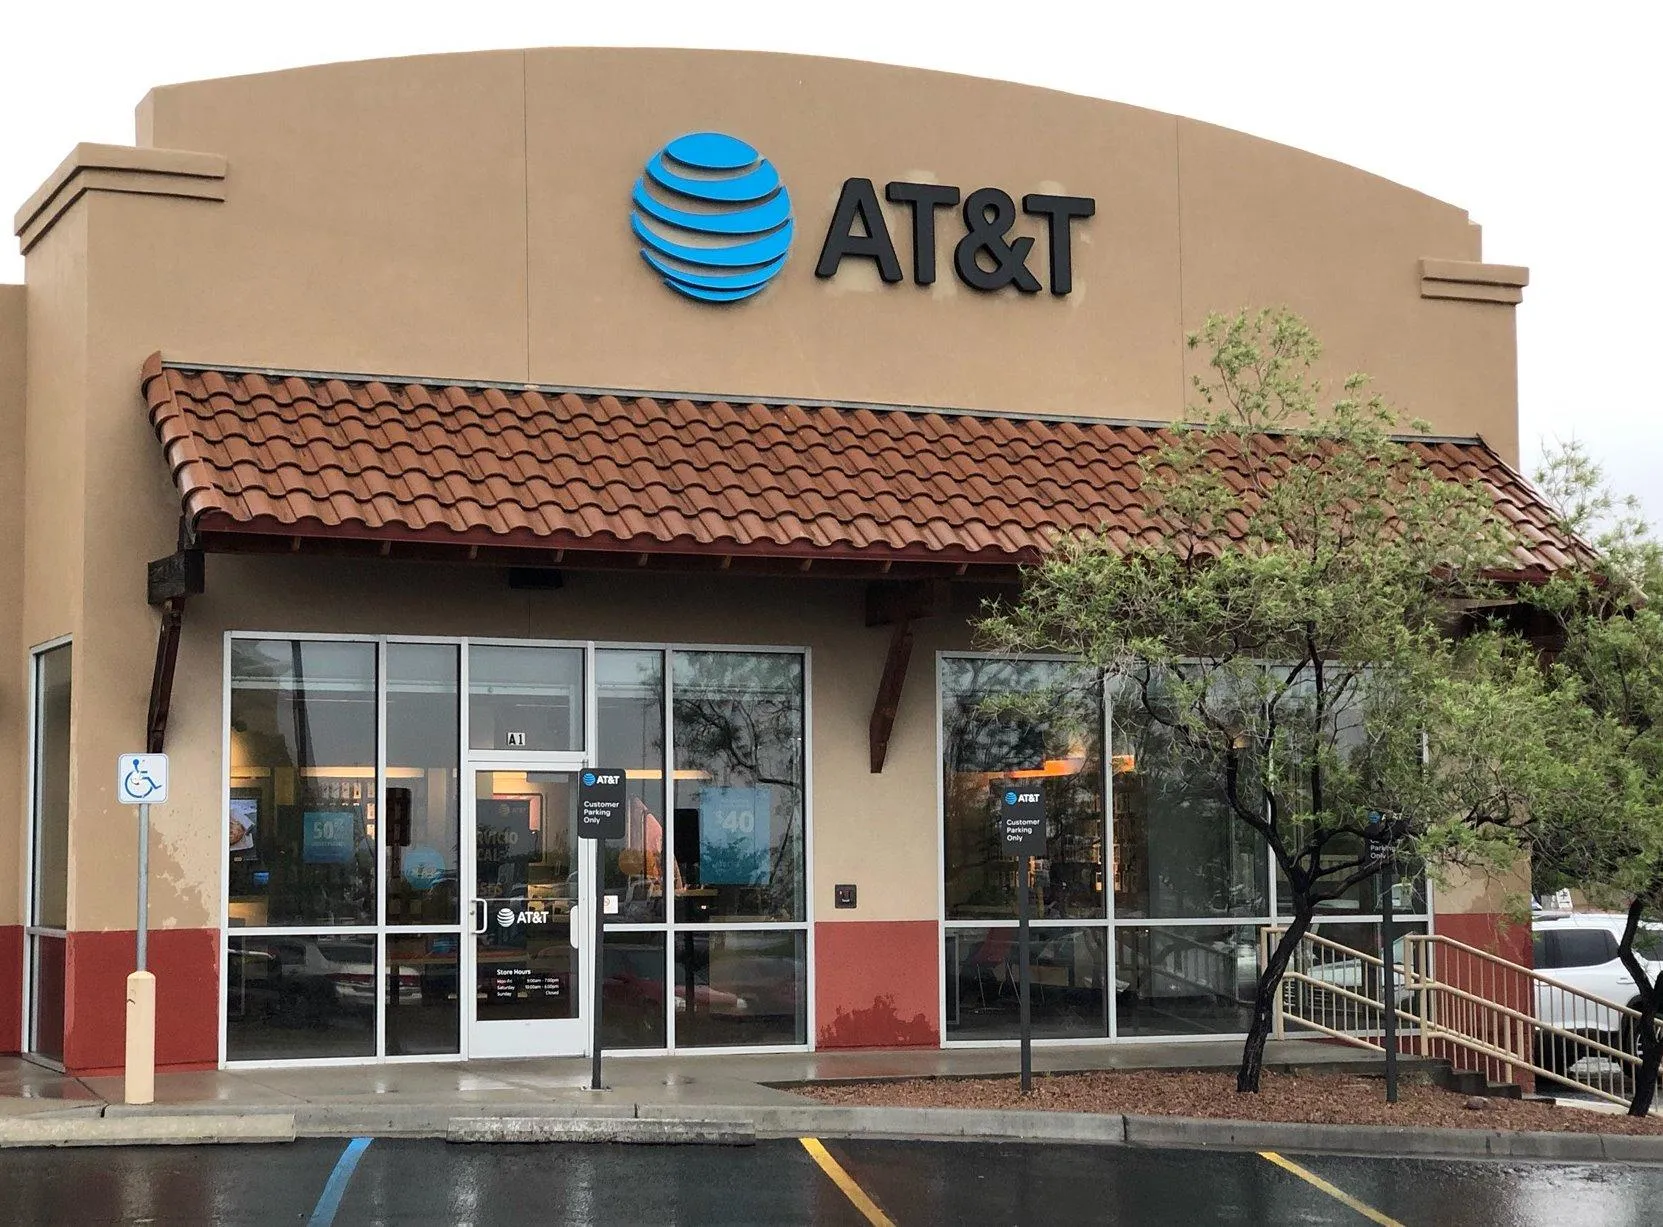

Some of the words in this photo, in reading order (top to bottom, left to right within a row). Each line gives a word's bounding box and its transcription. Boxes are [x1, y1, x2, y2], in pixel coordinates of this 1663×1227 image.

[815, 177, 1096, 296] AT&T
[596, 775, 620, 785] AT&T
[1018, 793, 1040, 803] AT&T
[583, 800, 620, 808] Customer
[583, 808, 611, 817] Parking
[583, 816, 601, 825] Only
[1006, 826, 1033, 835] Parking
[1006, 834, 1023, 842] Only
[516, 911, 549, 923] AT&T
